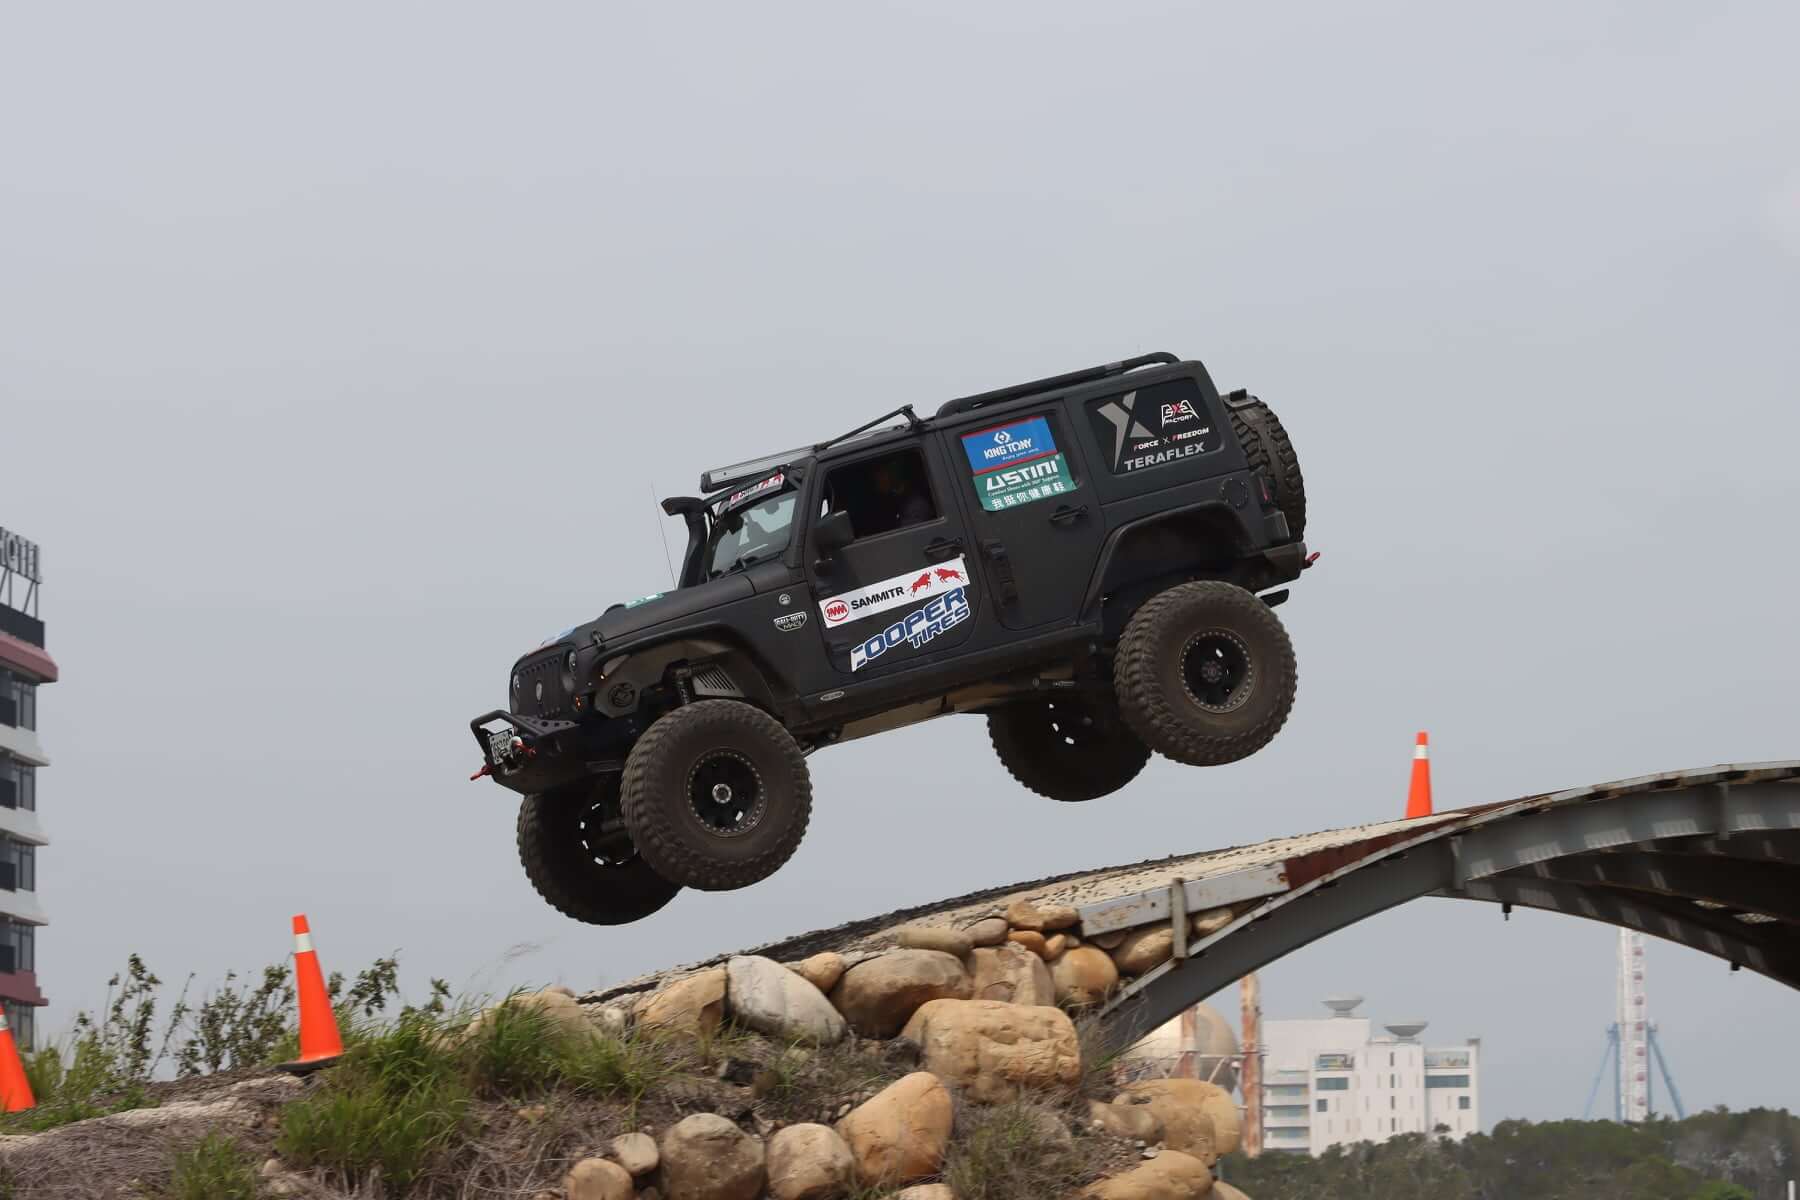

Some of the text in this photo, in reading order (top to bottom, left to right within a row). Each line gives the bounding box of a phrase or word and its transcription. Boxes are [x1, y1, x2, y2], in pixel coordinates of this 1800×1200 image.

[984, 443, 1007, 459] KING
[1007, 438, 1032, 453] TONY
[1133, 439, 1159, 452] FORCE
[1172, 427, 1210, 441] FREEDOM
[1124, 441, 1205, 471] TERAFLEX
[986, 460, 1058, 491] USTINI
[851, 586, 905, 610] SAMMITR
[908, 605, 970, 648] TIRES
